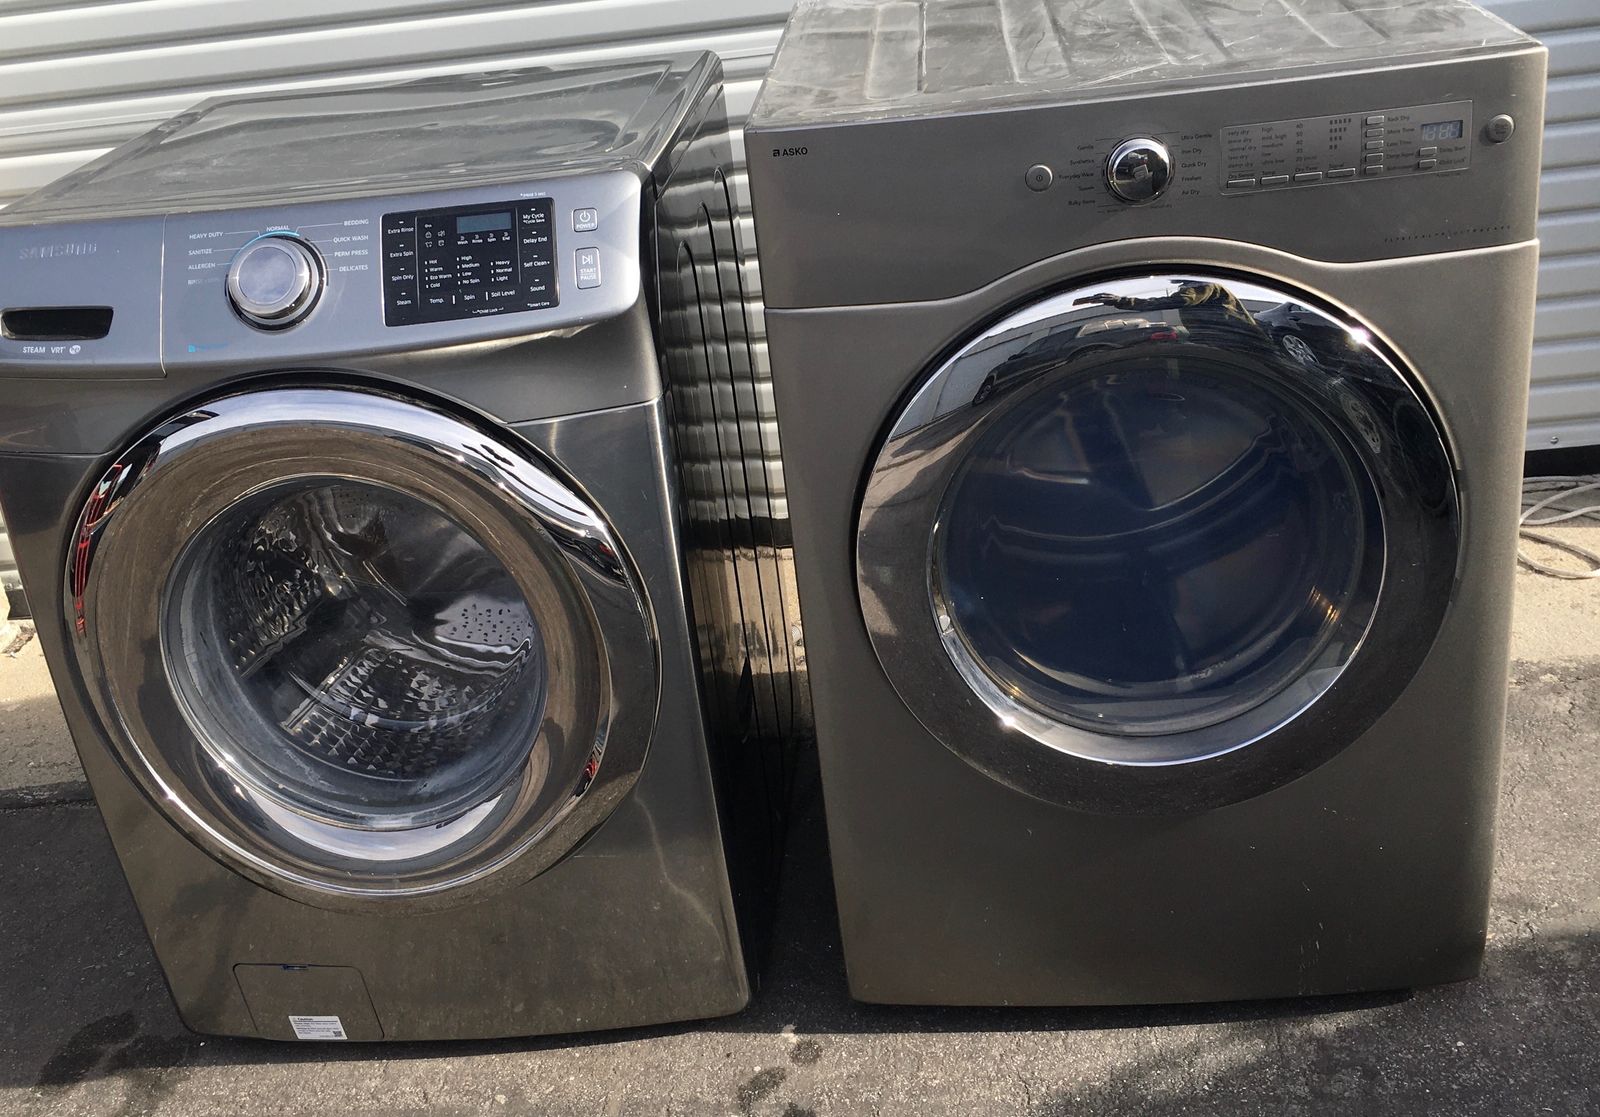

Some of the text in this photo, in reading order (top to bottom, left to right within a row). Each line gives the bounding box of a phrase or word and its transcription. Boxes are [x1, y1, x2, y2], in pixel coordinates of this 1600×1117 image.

[782, 146, 808, 157] ASKO
[343, 218, 369, 227] BEDDING
[576, 222, 596, 230] POWER
[265, 224, 291, 233] NORMAL
[189, 231, 224, 241] HEAVY DUTY
[351, 234, 369, 242] WASH
[188, 248, 213, 256] SANITIZE
[334, 248, 369, 258] PERM PRESS
[187, 263, 216, 271] ALLERGEN
[338, 264, 369, 273] DELICATES
[530, 285, 546, 293] Sound
[491, 289, 516, 299] Soil Level
[22, 346, 46, 354] STEAM
